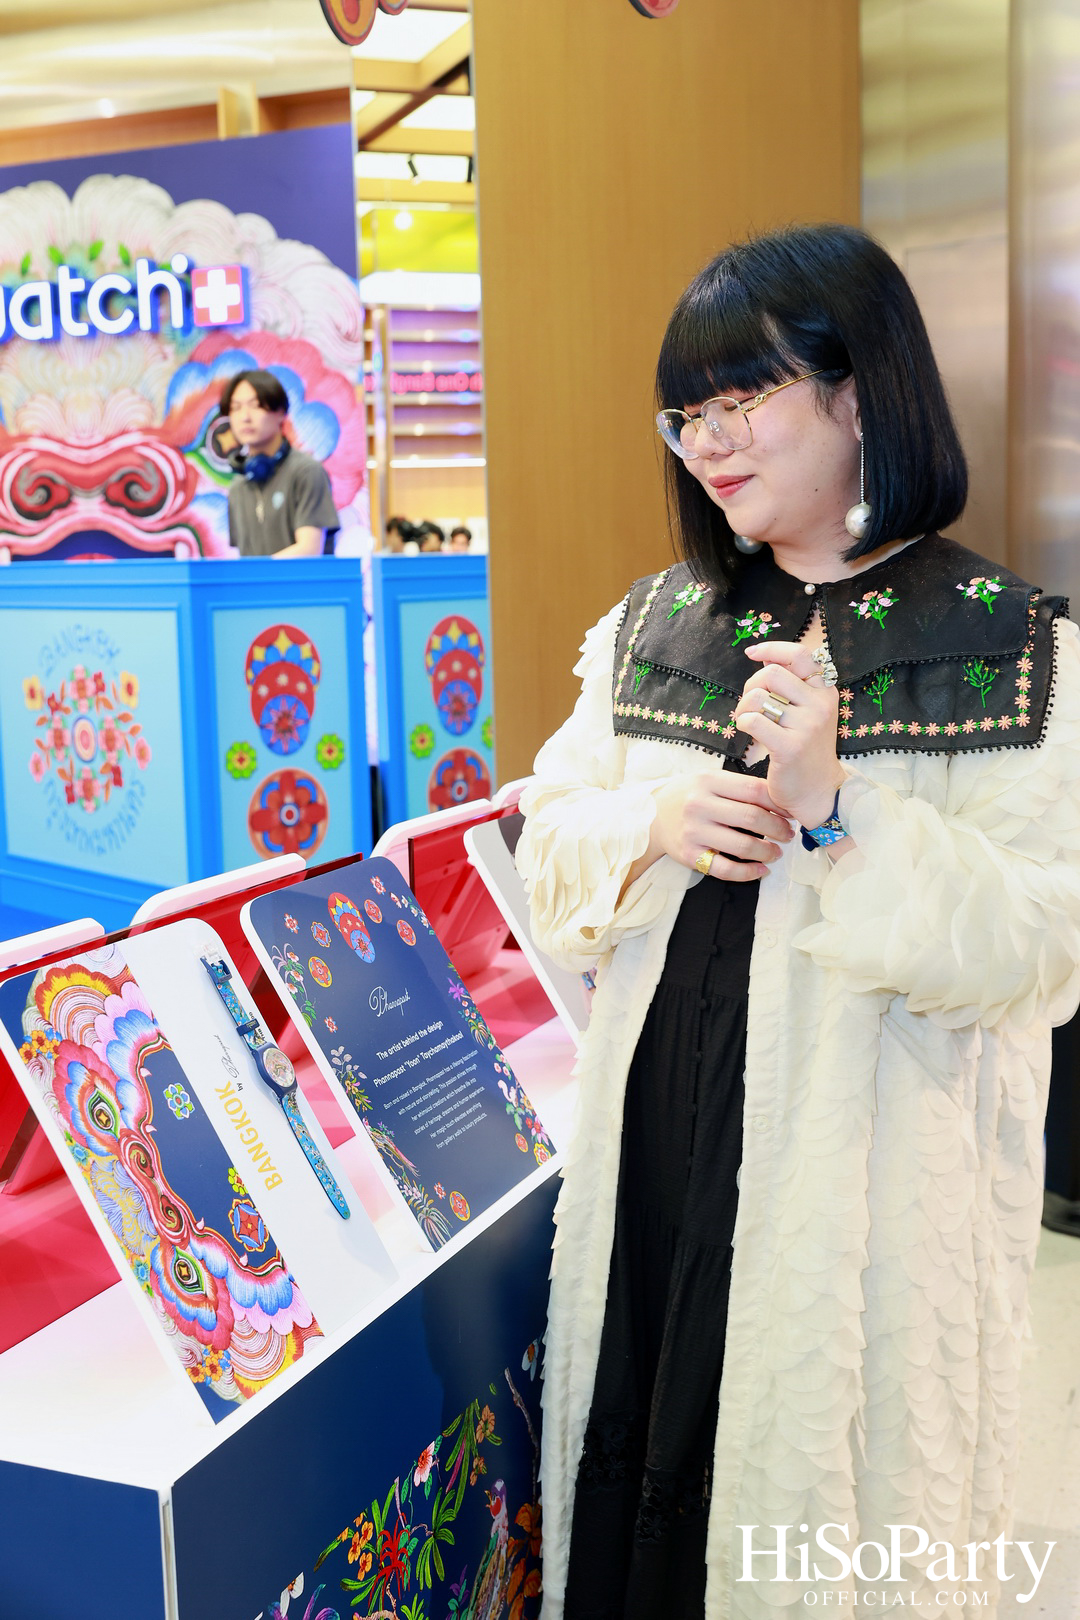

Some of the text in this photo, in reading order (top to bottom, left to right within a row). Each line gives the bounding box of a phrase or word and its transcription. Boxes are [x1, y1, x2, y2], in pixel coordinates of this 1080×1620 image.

[376, 1020, 444, 1061] The artist behind the design
[235, 1081, 245, 1093] by
[373, 1064, 407, 1088] Phannapast
[383, 1101, 393, 1110] Born
[391, 1096, 400, 1105] and
[399, 1091, 411, 1101] raised
[425, 1069, 445, 1083] Phannapast
[397, 1108, 407, 1116] with
[404, 1101, 417, 1112] nature
[415, 1096, 424, 1105] and
[438, 1082, 447, 1090] This
[445, 1076, 458, 1087] passion
[456, 1070, 467, 1080] shines
[464, 1063, 478, 1074] through
[414, 1124, 426, 1136] stories
[424, 1120, 430, 1128] of
[441, 1106, 454, 1117] dreams
[452, 1101, 460, 1110] and
[458, 1095, 470, 1105] human
[417, 1104, 434, 1118] whimsical
[431, 1096, 448, 1109] creations
[445, 1090, 456, 1100] which
[453, 1084, 467, 1095] breathe
[469, 1077, 477, 1085] into
[214, 1080, 284, 1192] BANGKOK
[430, 1101, 483, 1139] Her magic touch elevates everything
[435, 1141, 446, 1150] from
[443, 1134, 456, 1146] gallery
[454, 1129, 464, 1137] walls
[460, 1125, 467, 1133] to
[464, 1120, 476, 1130] luxury
